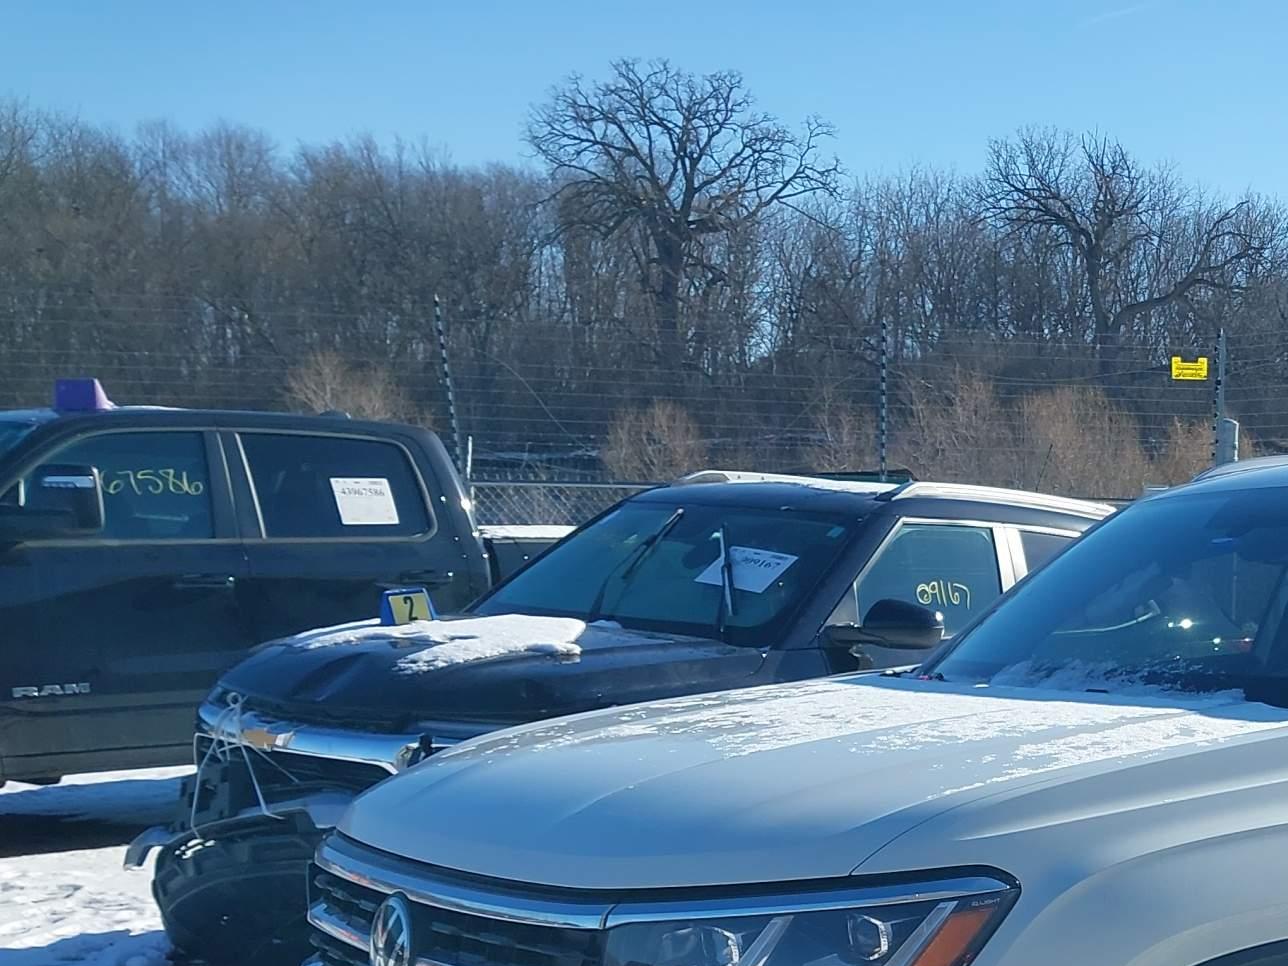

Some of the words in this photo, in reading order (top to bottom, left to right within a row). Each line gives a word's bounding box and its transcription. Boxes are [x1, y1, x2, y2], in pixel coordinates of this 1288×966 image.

[100, 469, 203, 495] 67586
[403, 595, 419, 621] 2
[11, 682, 90, 698] RAM
